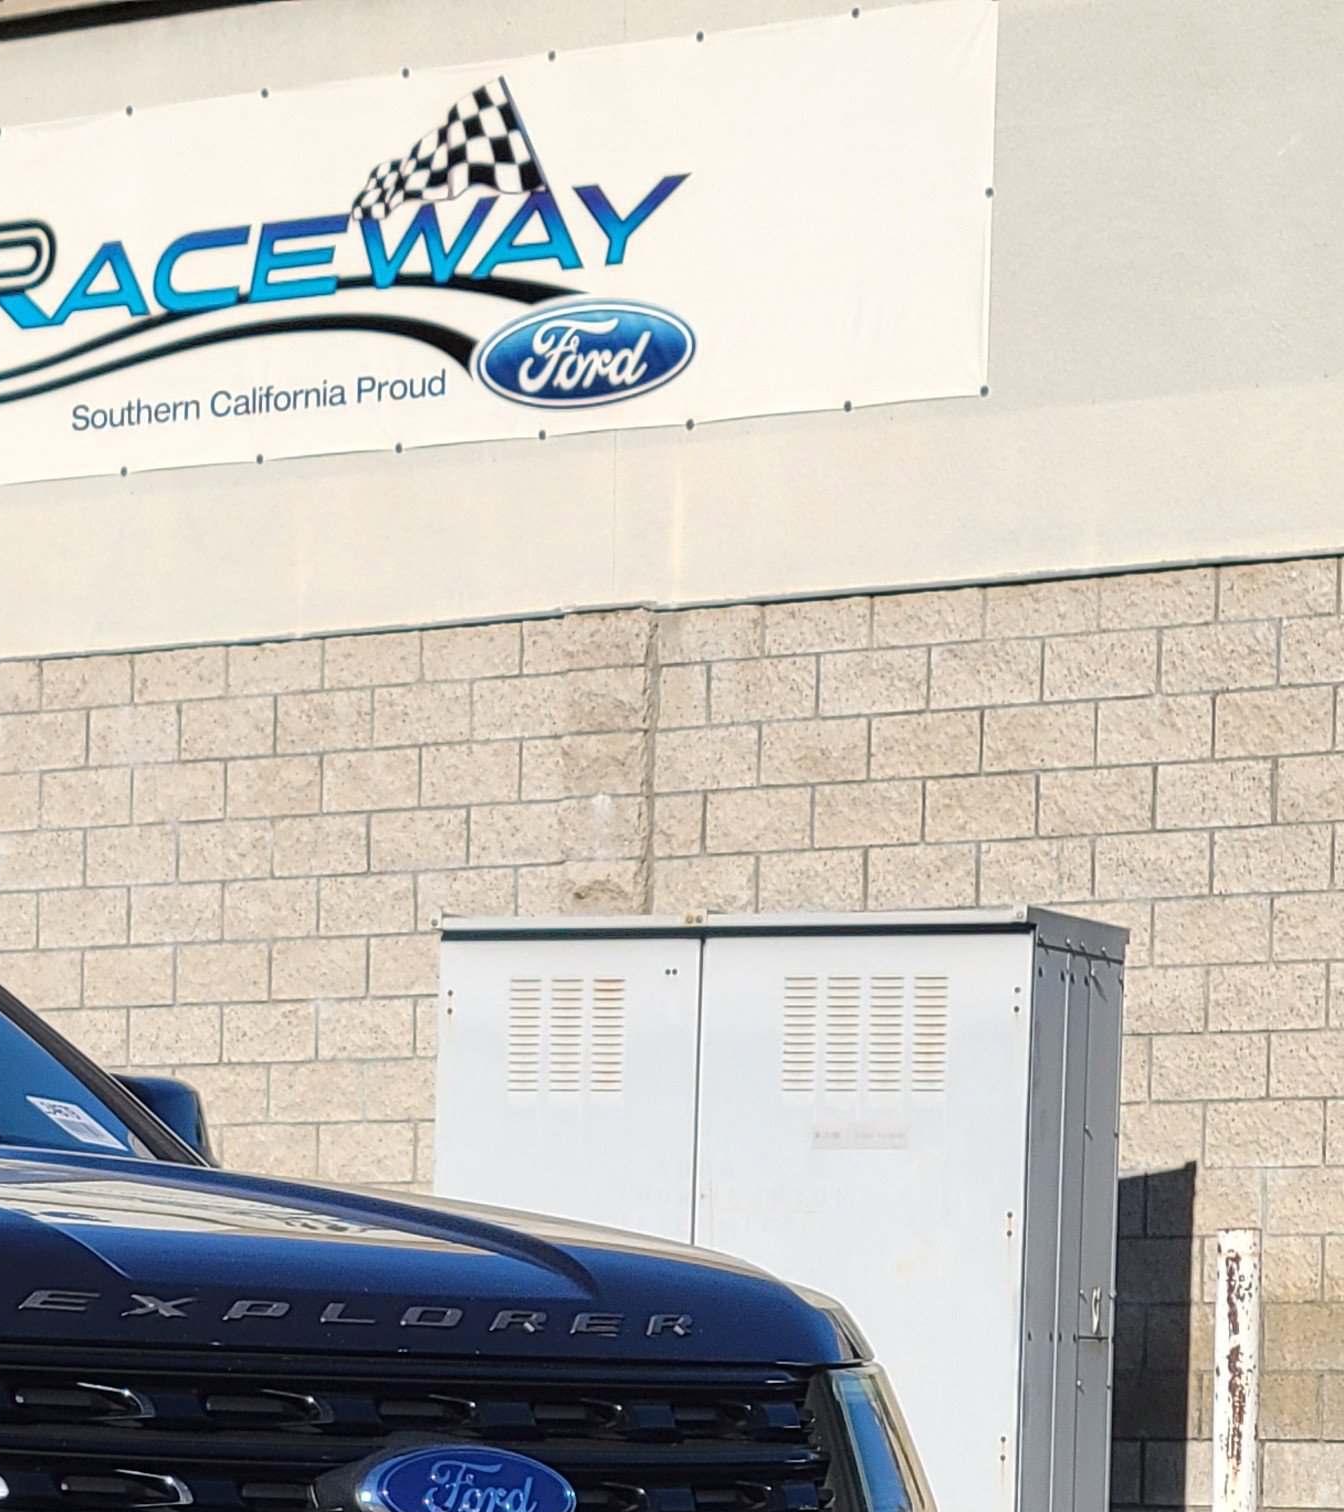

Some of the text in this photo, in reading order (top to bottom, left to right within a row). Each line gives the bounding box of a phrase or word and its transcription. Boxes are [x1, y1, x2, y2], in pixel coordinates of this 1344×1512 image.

[518, 318, 652, 392] Ford
[71, 368, 446, 431] Southern California Proud
[17, 1289, 694, 1337] EXPLORER
